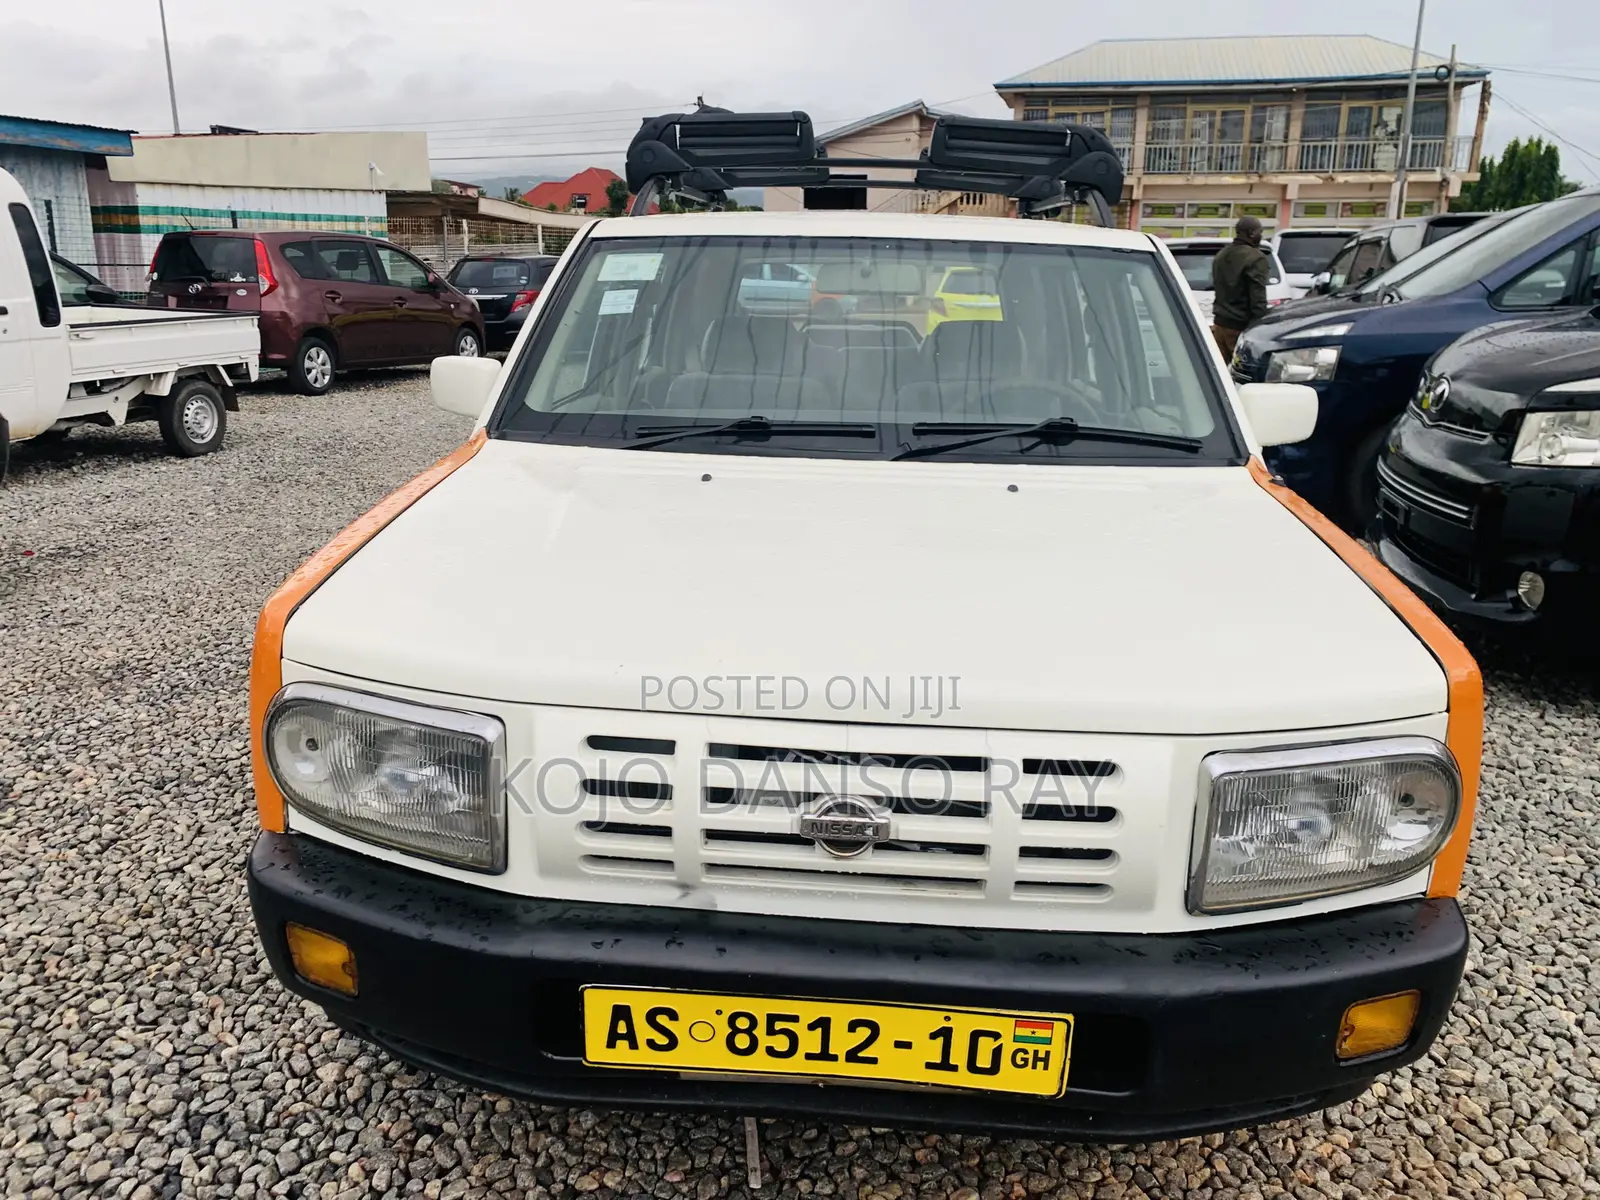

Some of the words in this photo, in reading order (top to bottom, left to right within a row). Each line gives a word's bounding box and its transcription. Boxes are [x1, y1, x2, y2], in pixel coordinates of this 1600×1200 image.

[810, 821, 880, 837] NISSAN
[606, 1004, 680, 1052] AS
[1010, 1047, 1051, 1071] GH
